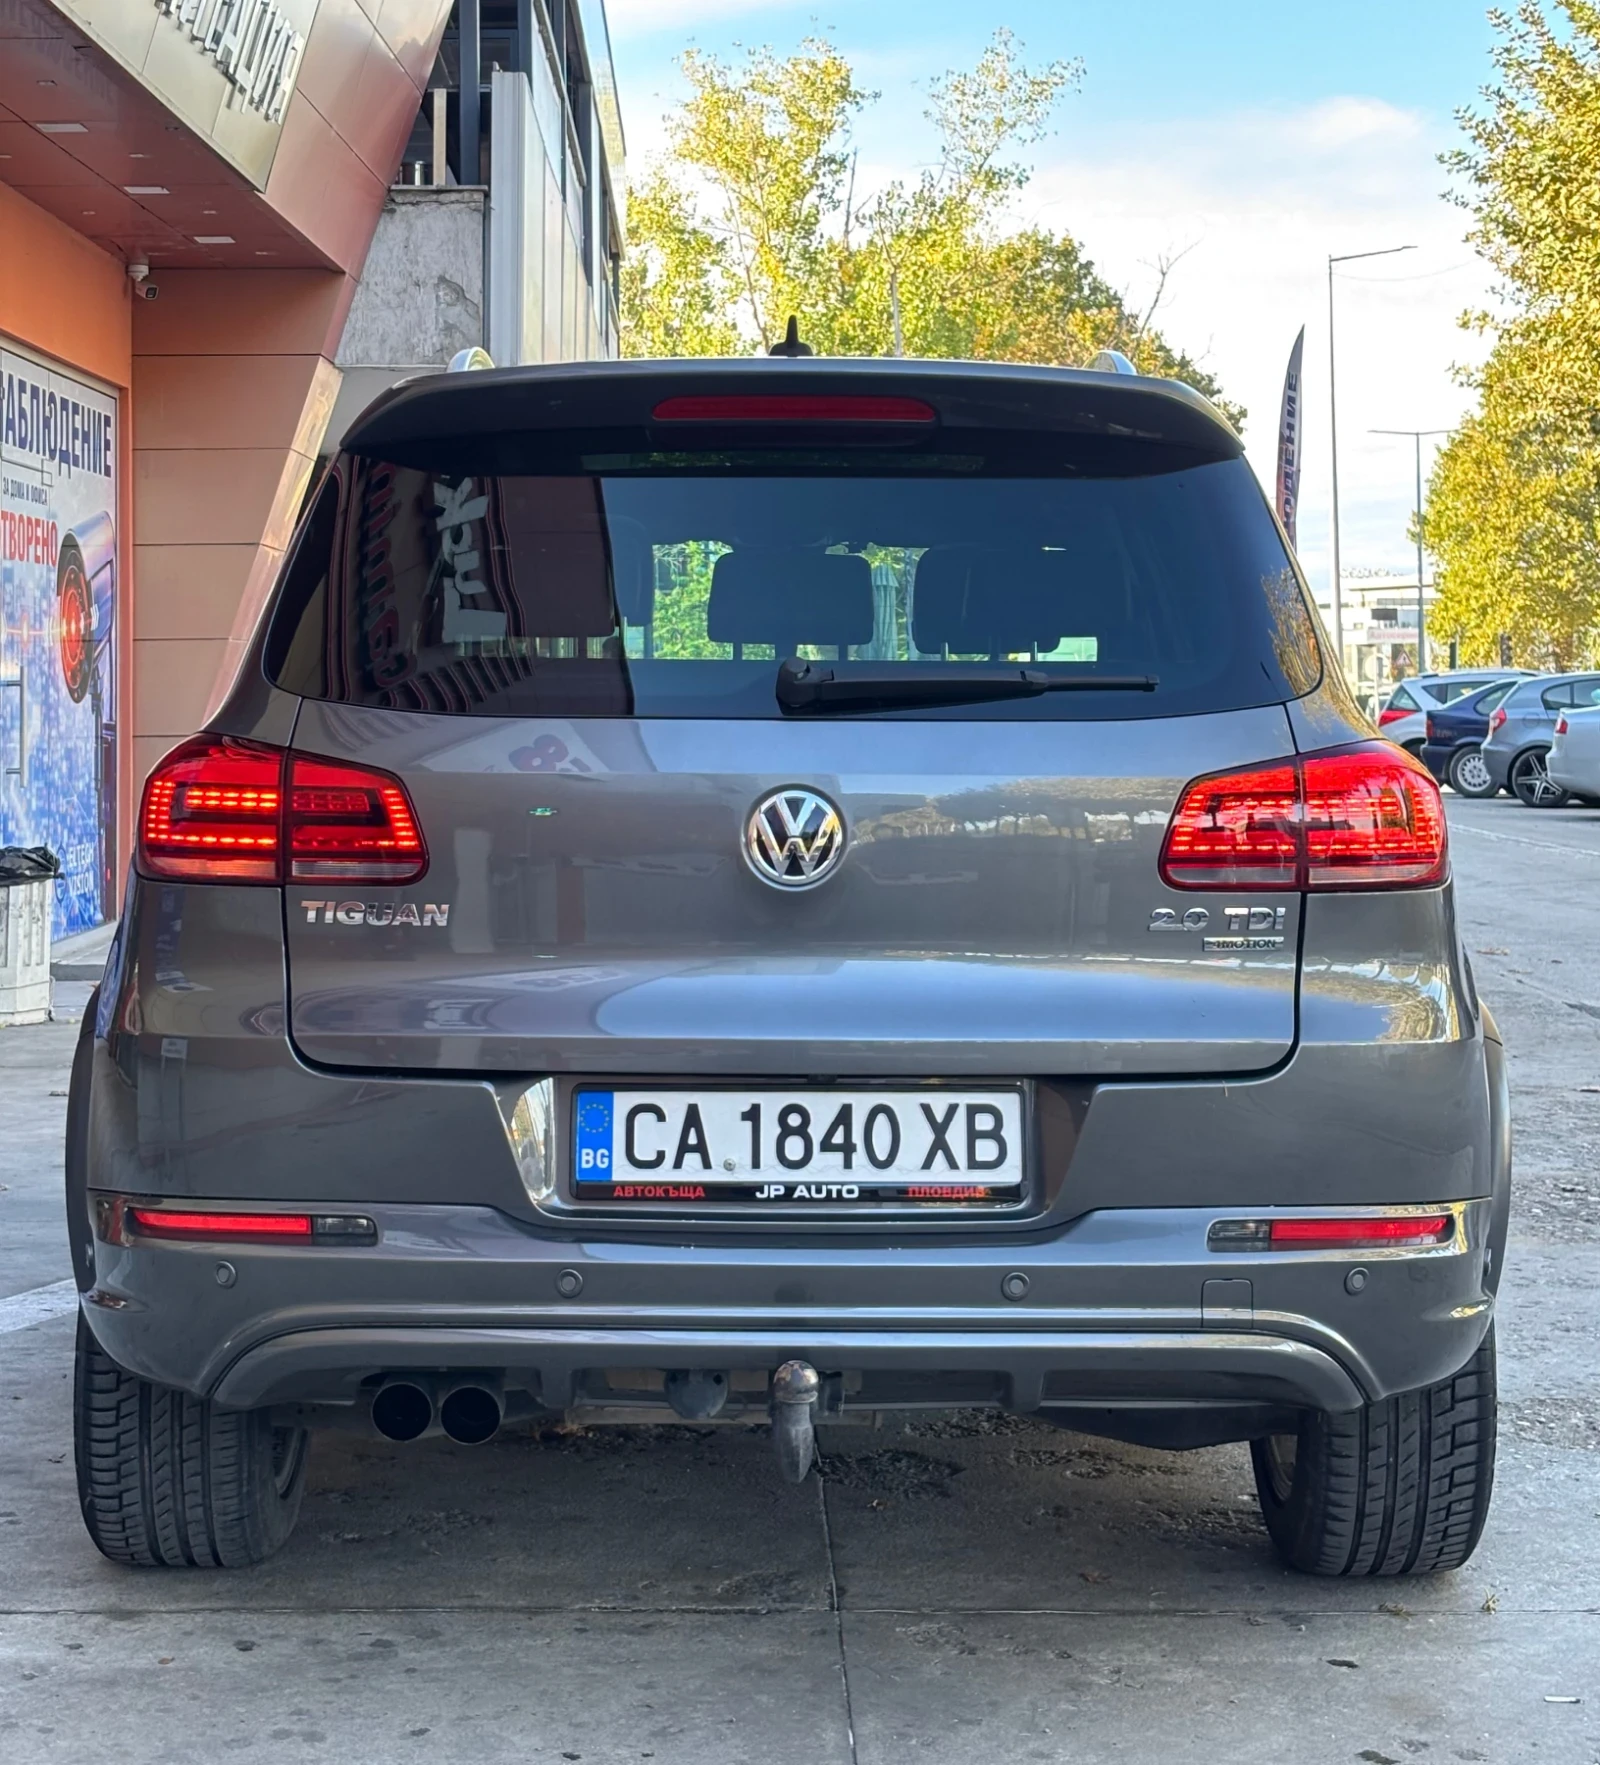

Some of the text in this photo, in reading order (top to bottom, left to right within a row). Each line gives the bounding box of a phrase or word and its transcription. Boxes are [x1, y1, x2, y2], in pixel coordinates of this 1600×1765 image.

[301, 900, 450, 926] TIGUAN
[1149, 907, 1286, 932] 2.0 TDI
[1212, 938, 1276, 949] 4MOTION
[625, 1103, 1009, 1171] CA 1840 XB
[581, 1149, 610, 1168] BG
[613, 1185, 706, 1199] АВТОКЪЩА
[755, 1184, 859, 1199] JP AUTO
[908, 1185, 985, 1199] ПЛОВДИВ
